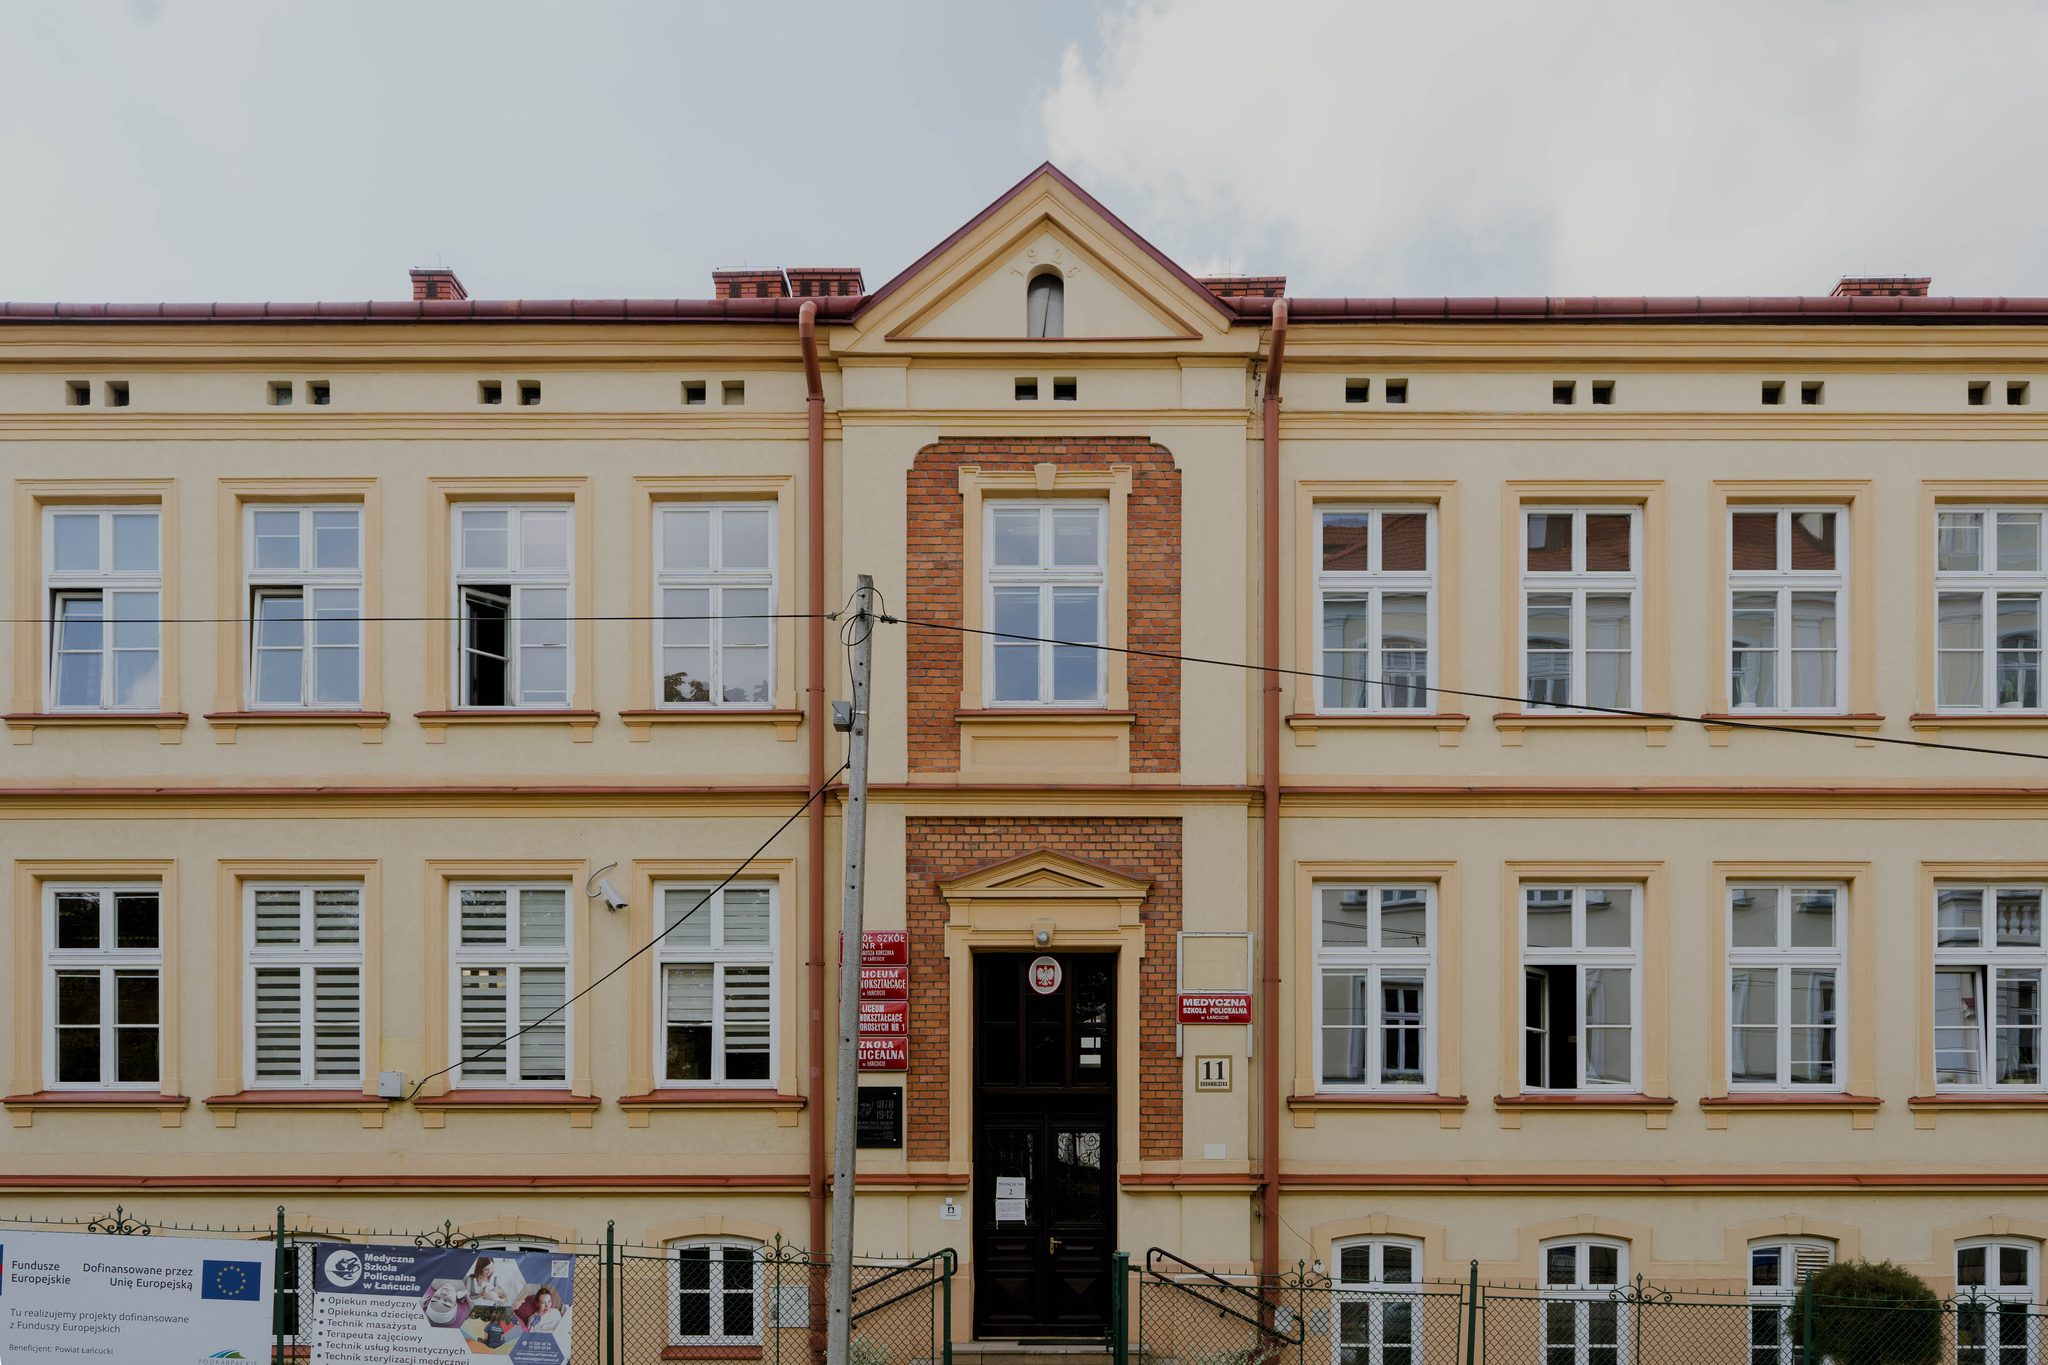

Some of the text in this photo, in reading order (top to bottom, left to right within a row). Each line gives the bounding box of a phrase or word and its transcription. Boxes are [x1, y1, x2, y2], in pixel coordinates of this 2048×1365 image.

[877, 933, 905, 943] SZKÓŁ
[862, 942, 883, 950] NR 1
[861, 970, 899, 978] LICEUM
[861, 979, 906, 989] NOKSZTAŁCĄCE
[862, 1004, 885, 1013] LICEUM
[859, 1013, 903, 1023] NOKSZTAŁCĄCE
[860, 1022, 905, 1032] OROSŁYCH NR 1
[860, 1040, 894, 1049] ZKOŁA
[859, 1049, 905, 1060] LICEALNA
[1203, 1060, 1225, 1080] 11
[364, 1253, 415, 1264] Medyczna
[12, 1260, 60, 1271] Fundusze
[83, 1263, 194, 1277] Dofinansowane przez
[363, 1262, 397, 1272] Szkoła
[11, 1273, 71, 1285] Europejskie
[363, 1271, 416, 1282] Policealna
[110, 1277, 193, 1291] Unię Europejską
[374, 1281, 421, 1292] Łańcucie
[328, 1296, 417, 1310] Opiekun medyczny
[10, 1308, 190, 1324] Tu realizujemy projekty dofinansowane
[327, 1307, 425, 1320] Opiekunka dziecięca
[17, 1321, 60, 1333] Funduszy
[62, 1322, 121, 1334] Europejskich
[327, 1318, 417, 1332] Technik masażysta
[326, 1329, 423, 1344] Terapeuta zajęciowy
[9, 1343, 114, 1355] Beneficjent: Powiat Łańcucki
[326, 1340, 466, 1356] Technik usług kosmetycznych
[325, 1351, 470, 1365] Technik sterylizacji medycznej
